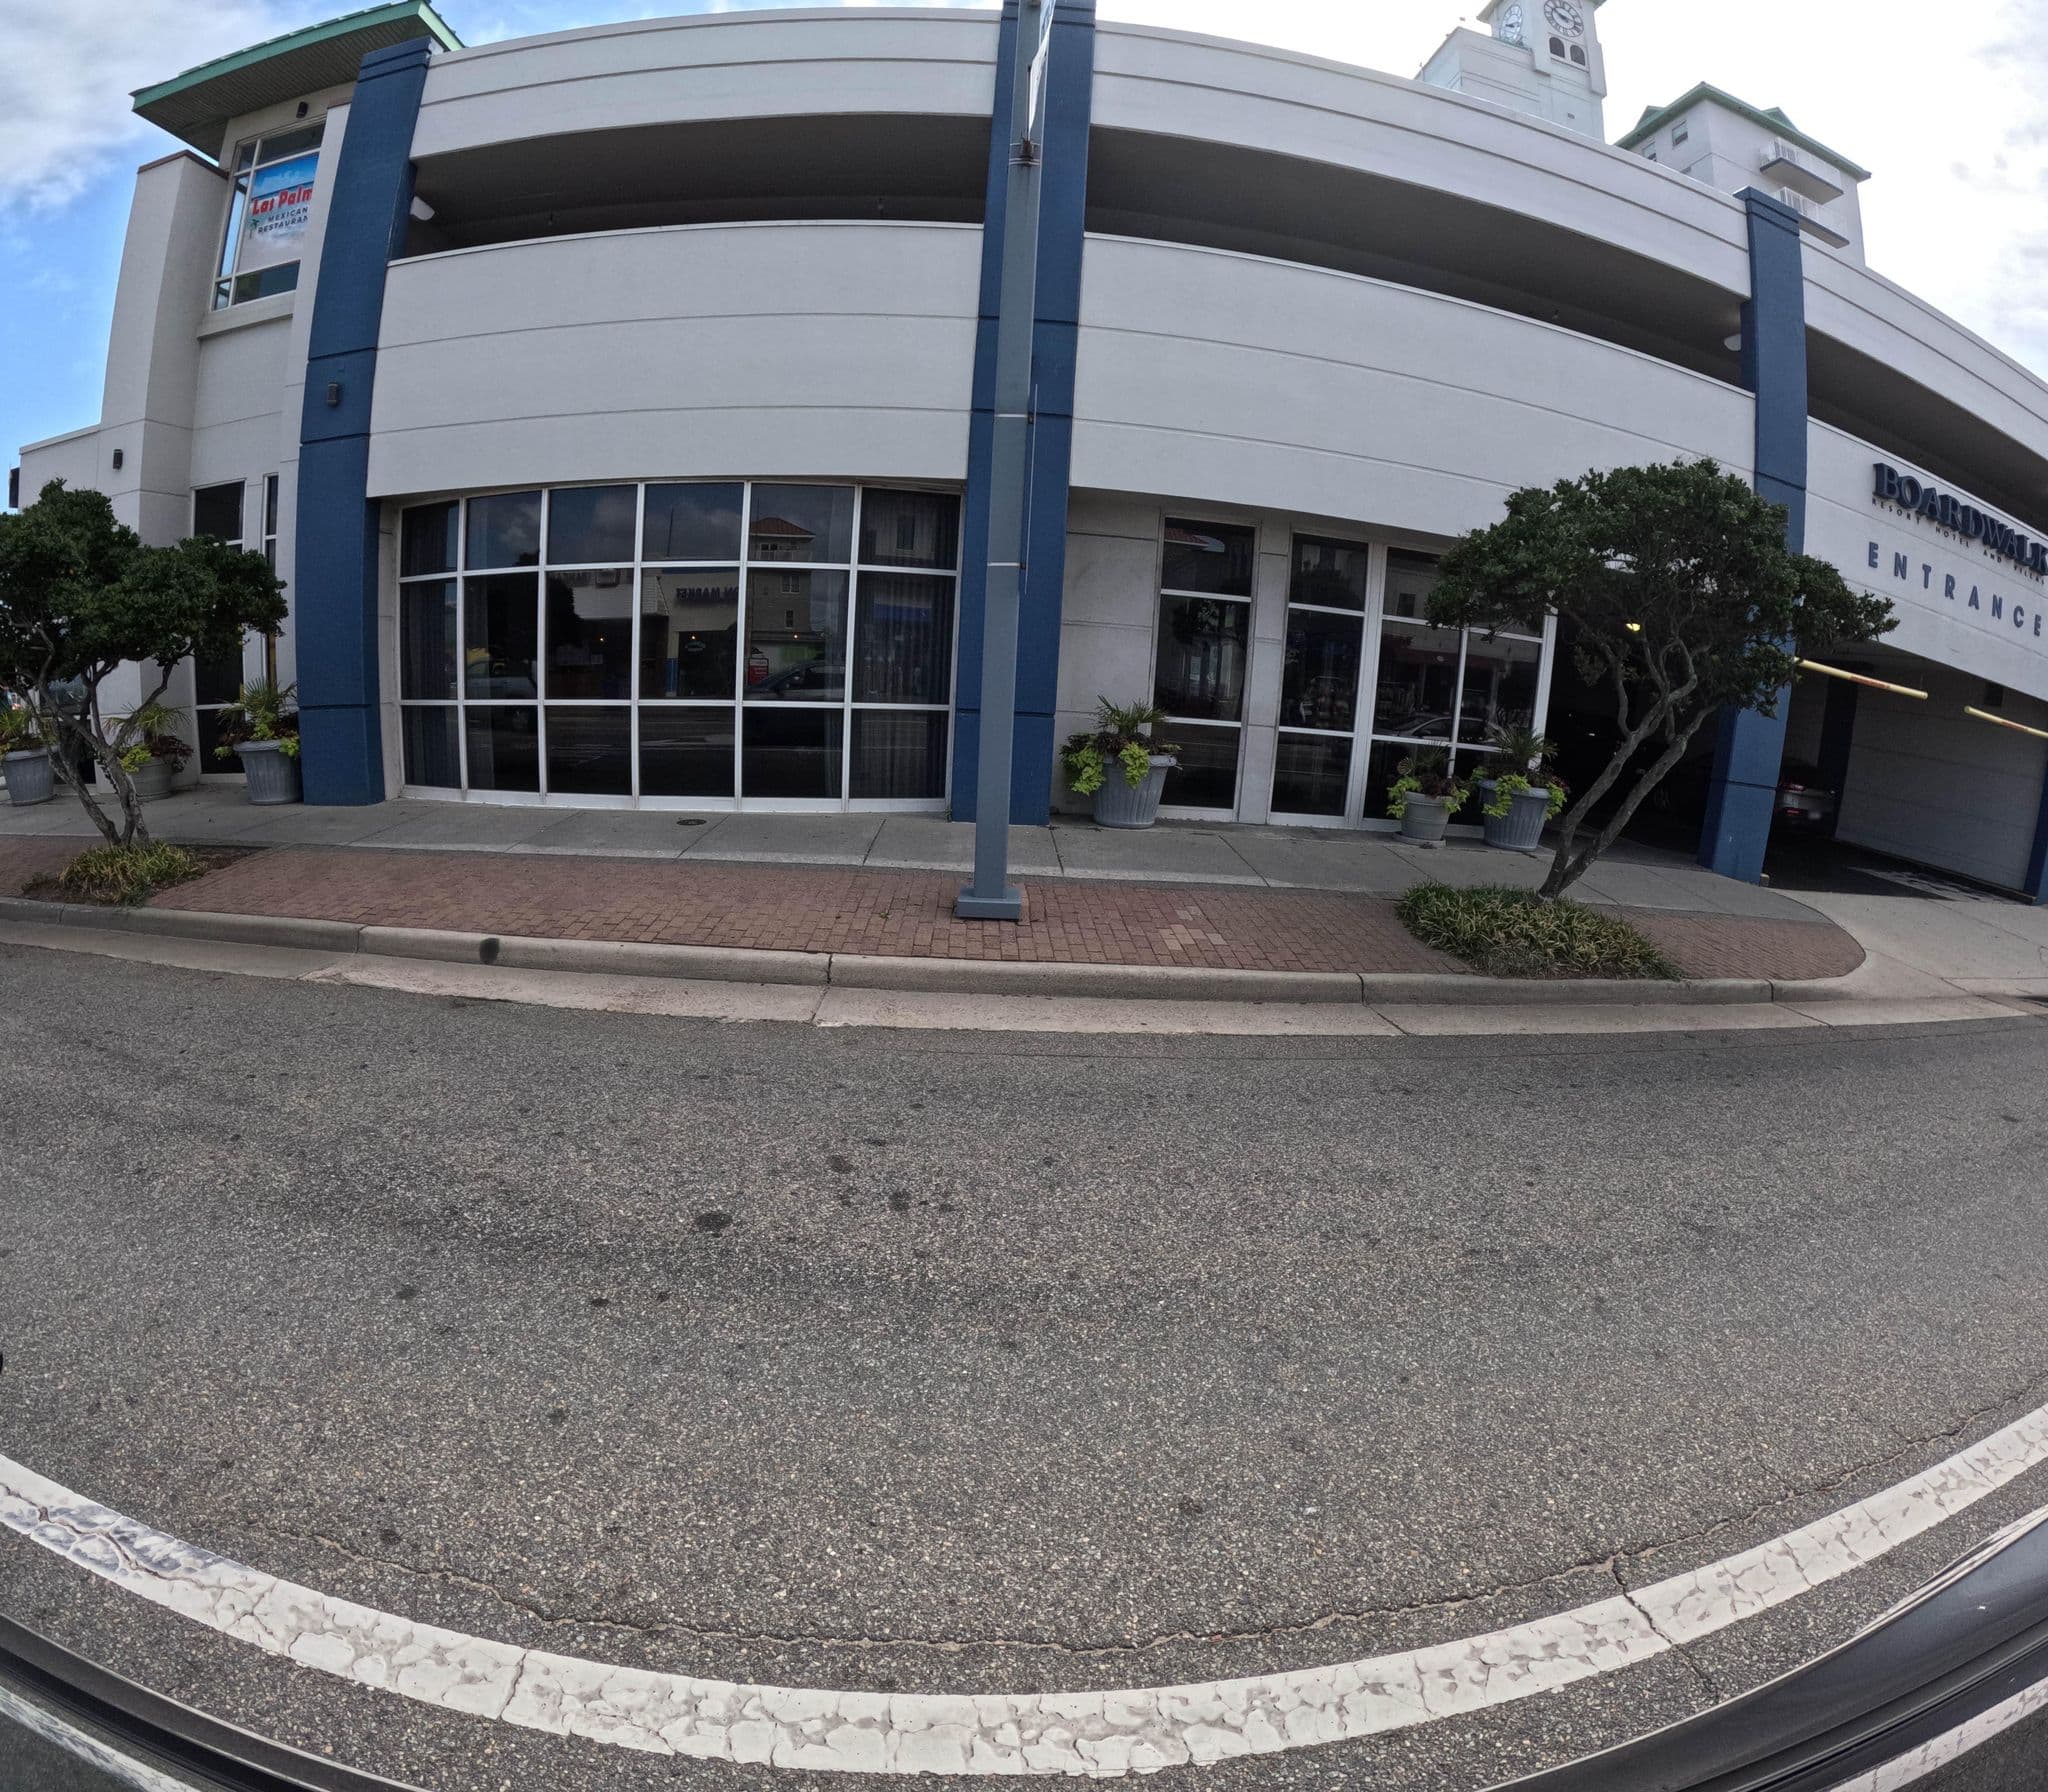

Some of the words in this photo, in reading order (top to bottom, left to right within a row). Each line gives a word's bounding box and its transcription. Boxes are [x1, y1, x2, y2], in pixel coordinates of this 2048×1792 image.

[252, 197, 274, 216] Las
[268, 207, 308, 222] MEXICAN
[1872, 463, 2048, 576] BOARDWALK
[1936, 526, 1969, 548] HOTEL
[1983, 549, 2002, 563] AND
[1868, 541, 2042, 637] ENTRANCE
